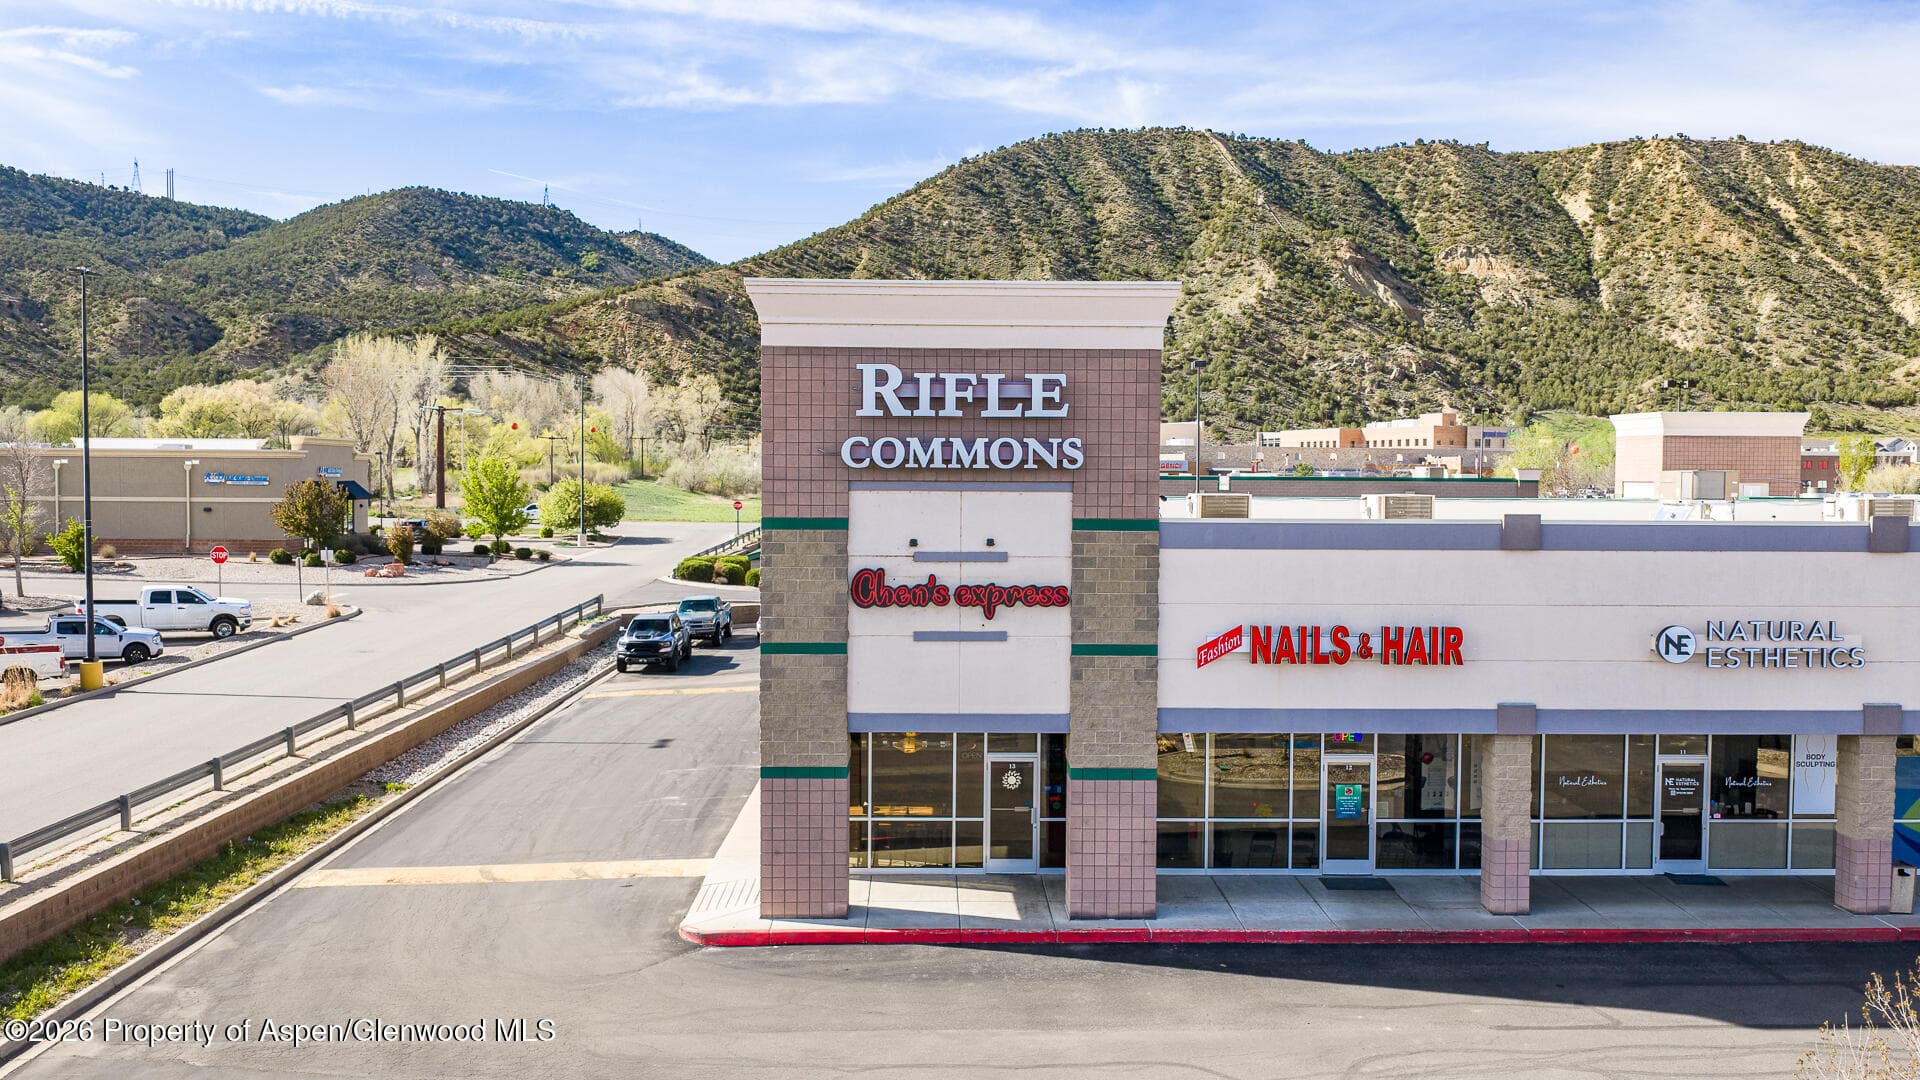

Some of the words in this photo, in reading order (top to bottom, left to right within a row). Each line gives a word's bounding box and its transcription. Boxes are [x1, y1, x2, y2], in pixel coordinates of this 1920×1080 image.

[855, 363, 1069, 418] RIFLE
[840, 436, 1084, 470] COMMONS
[851, 568, 950, 608] Chen's
[954, 583, 1070, 620] express
[1198, 633, 1241, 667] Fashion
[1249, 625, 1352, 666] NAILS
[1357, 632, 1374, 659] &
[1381, 626, 1465, 666] HAIR
[1664, 633, 1691, 656] NE
[1706, 620, 1845, 642] NATURAL
[1705, 647, 1866, 669] ESTHETICS
